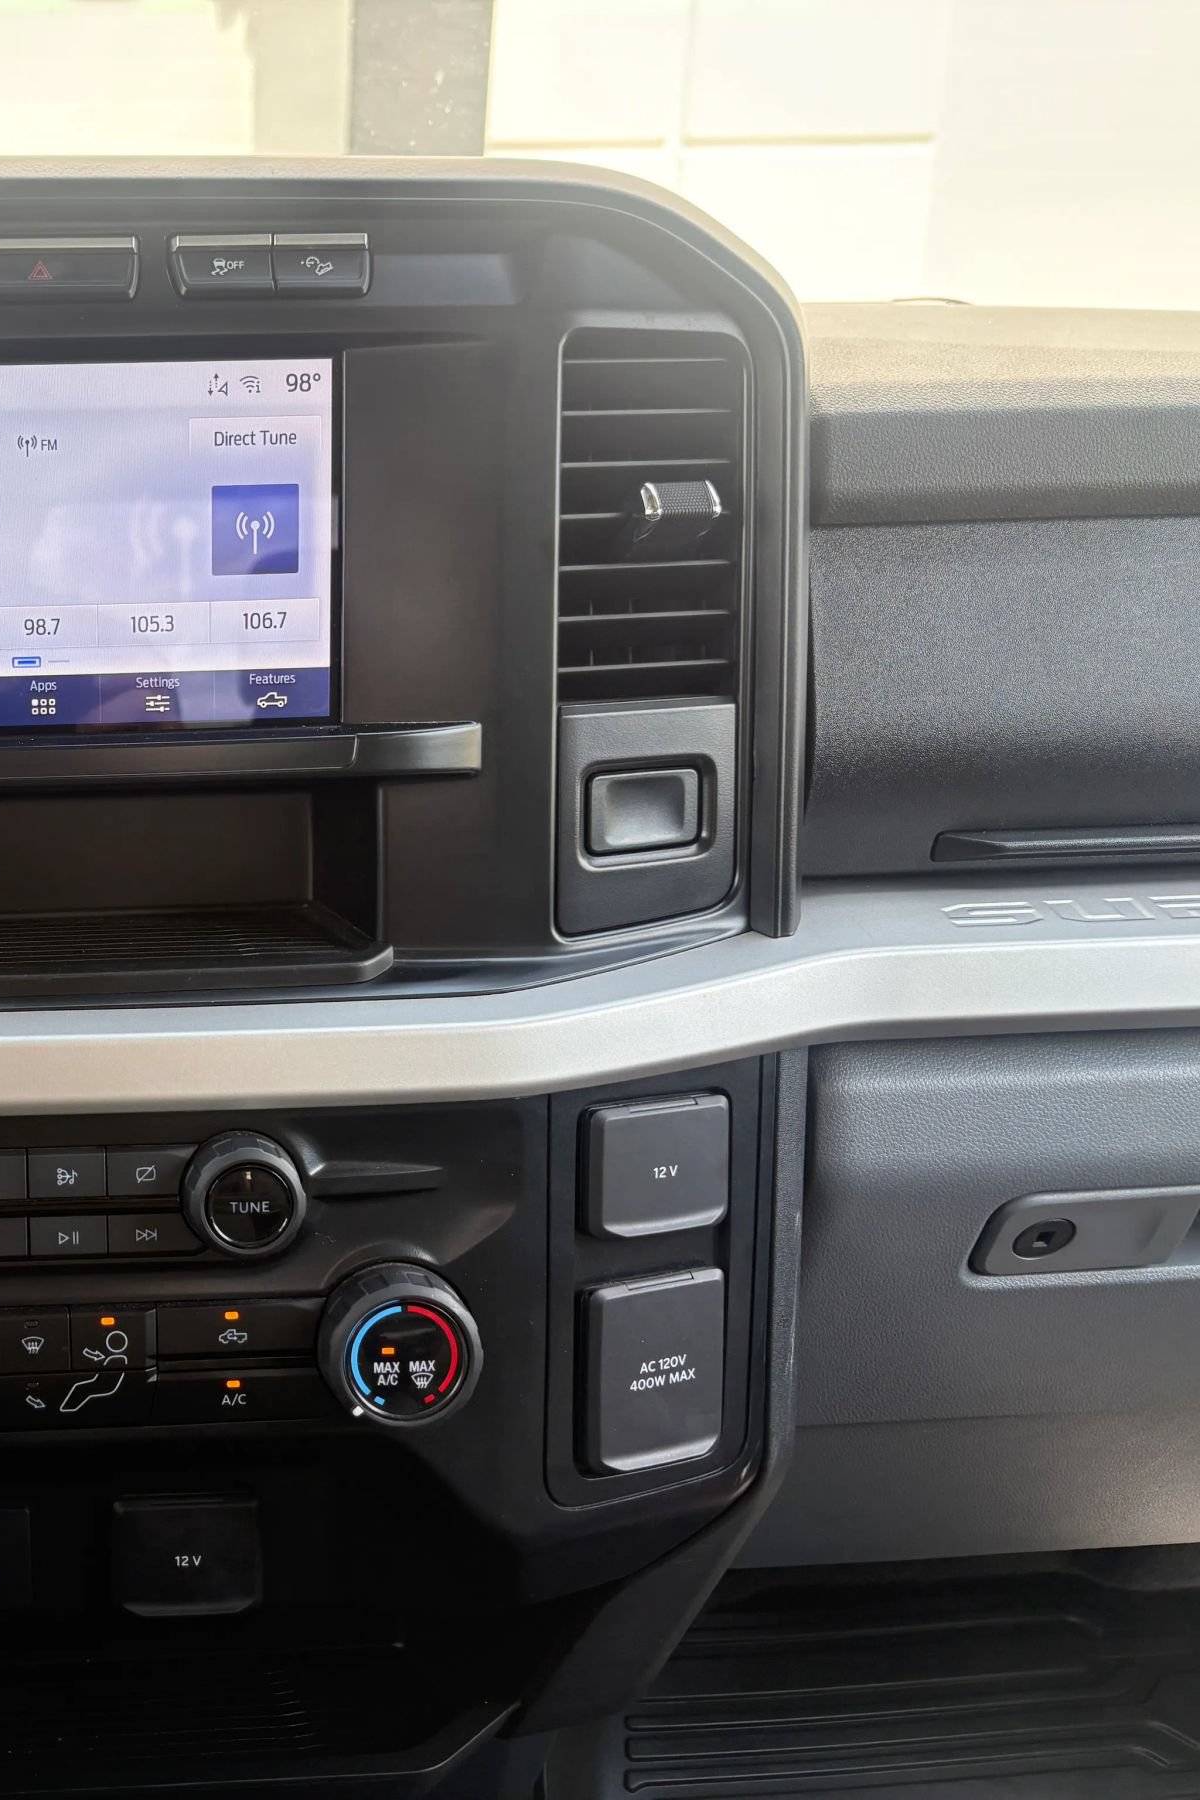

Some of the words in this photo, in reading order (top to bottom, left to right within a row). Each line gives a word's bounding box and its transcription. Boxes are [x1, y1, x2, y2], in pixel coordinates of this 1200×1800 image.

[226, 260, 245, 270] OFF
[285, 372, 322, 393] 98°
[40, 439, 58, 451] FM
[213, 430, 256, 447] Direct
[259, 429, 297, 446] Tune
[23, 618, 61, 636] 98.7
[130, 615, 175, 633] 105.3
[242, 611, 288, 630] 106.7
[29, 680, 58, 693] Apps
[135, 676, 181, 690] Settings
[249, 673, 296, 686] Features
[653, 1166, 667, 1179] 12
[668, 1164, 678, 1177] V
[229, 1200, 270, 1214] TUNE
[373, 1361, 400, 1374] MAX
[408, 1359, 436, 1372] MAX
[639, 1360, 656, 1375] AC
[657, 1354, 687, 1371] 120V
[377, 1373, 398, 1386] A/C
[629, 1374, 666, 1391] 400W
[668, 1367, 696, 1385] MAX
[221, 1393, 247, 1406] A/C
[174, 1555, 189, 1567] 12
[192, 1554, 202, 1567] V
